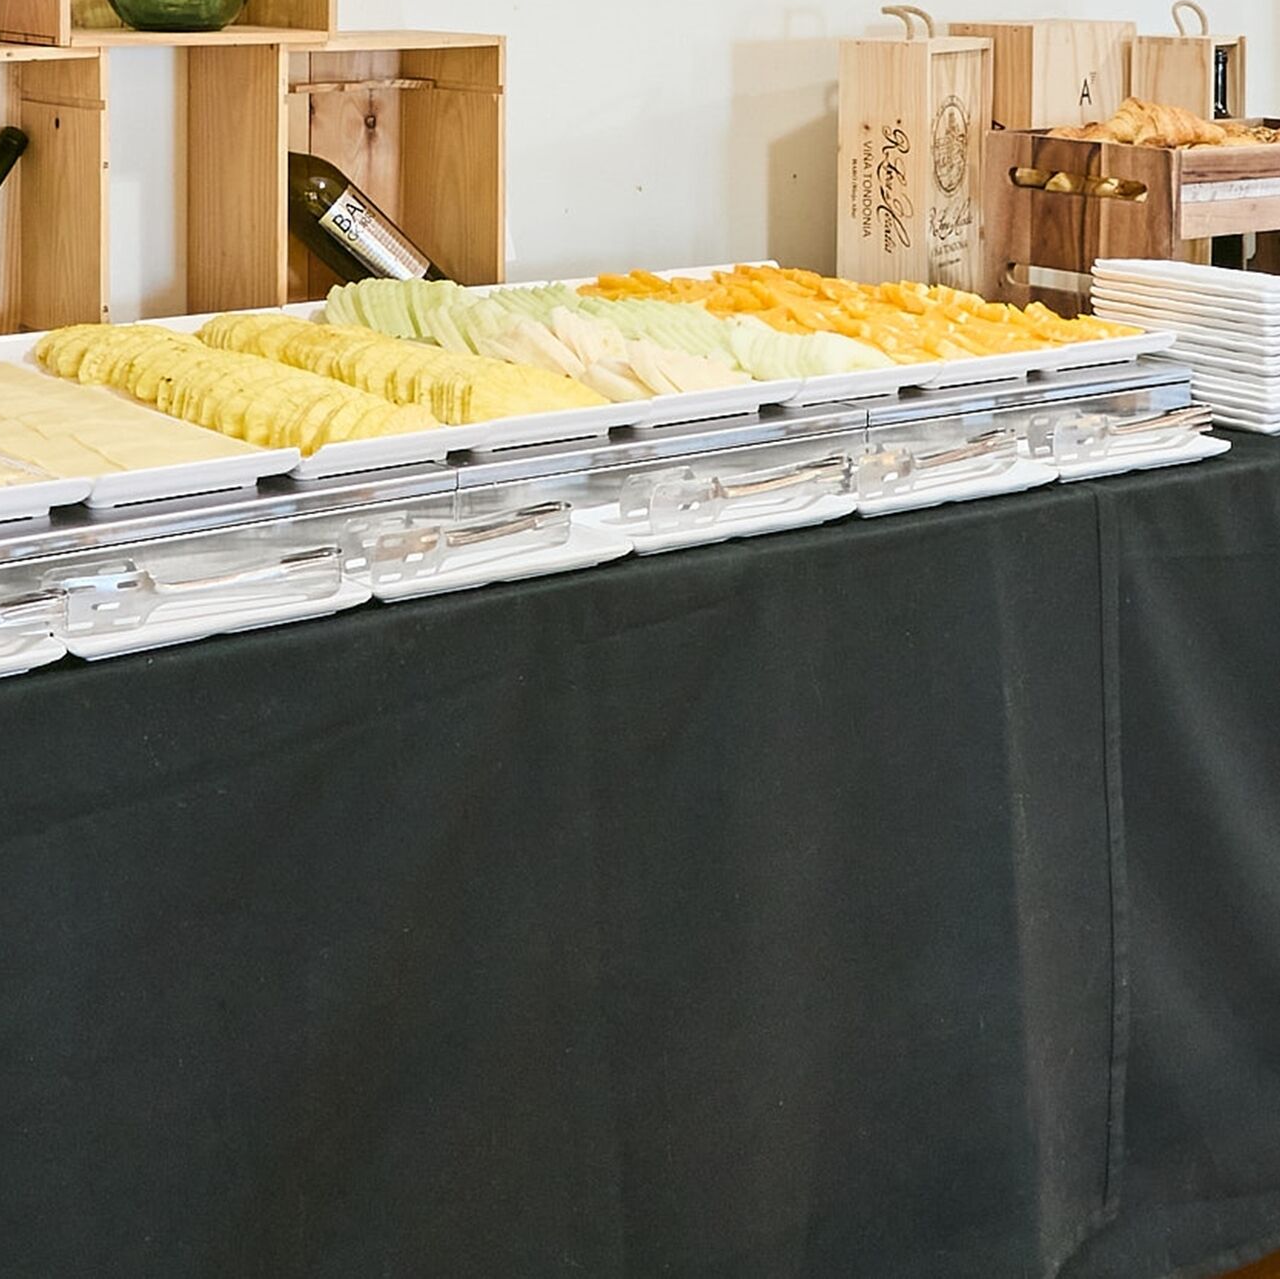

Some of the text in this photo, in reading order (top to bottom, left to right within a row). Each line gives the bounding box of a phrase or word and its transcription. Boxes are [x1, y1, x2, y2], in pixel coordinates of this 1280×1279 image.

[332, 194, 367, 233] BAI
[862, 140, 874, 238] VIÑA TONDONIA
